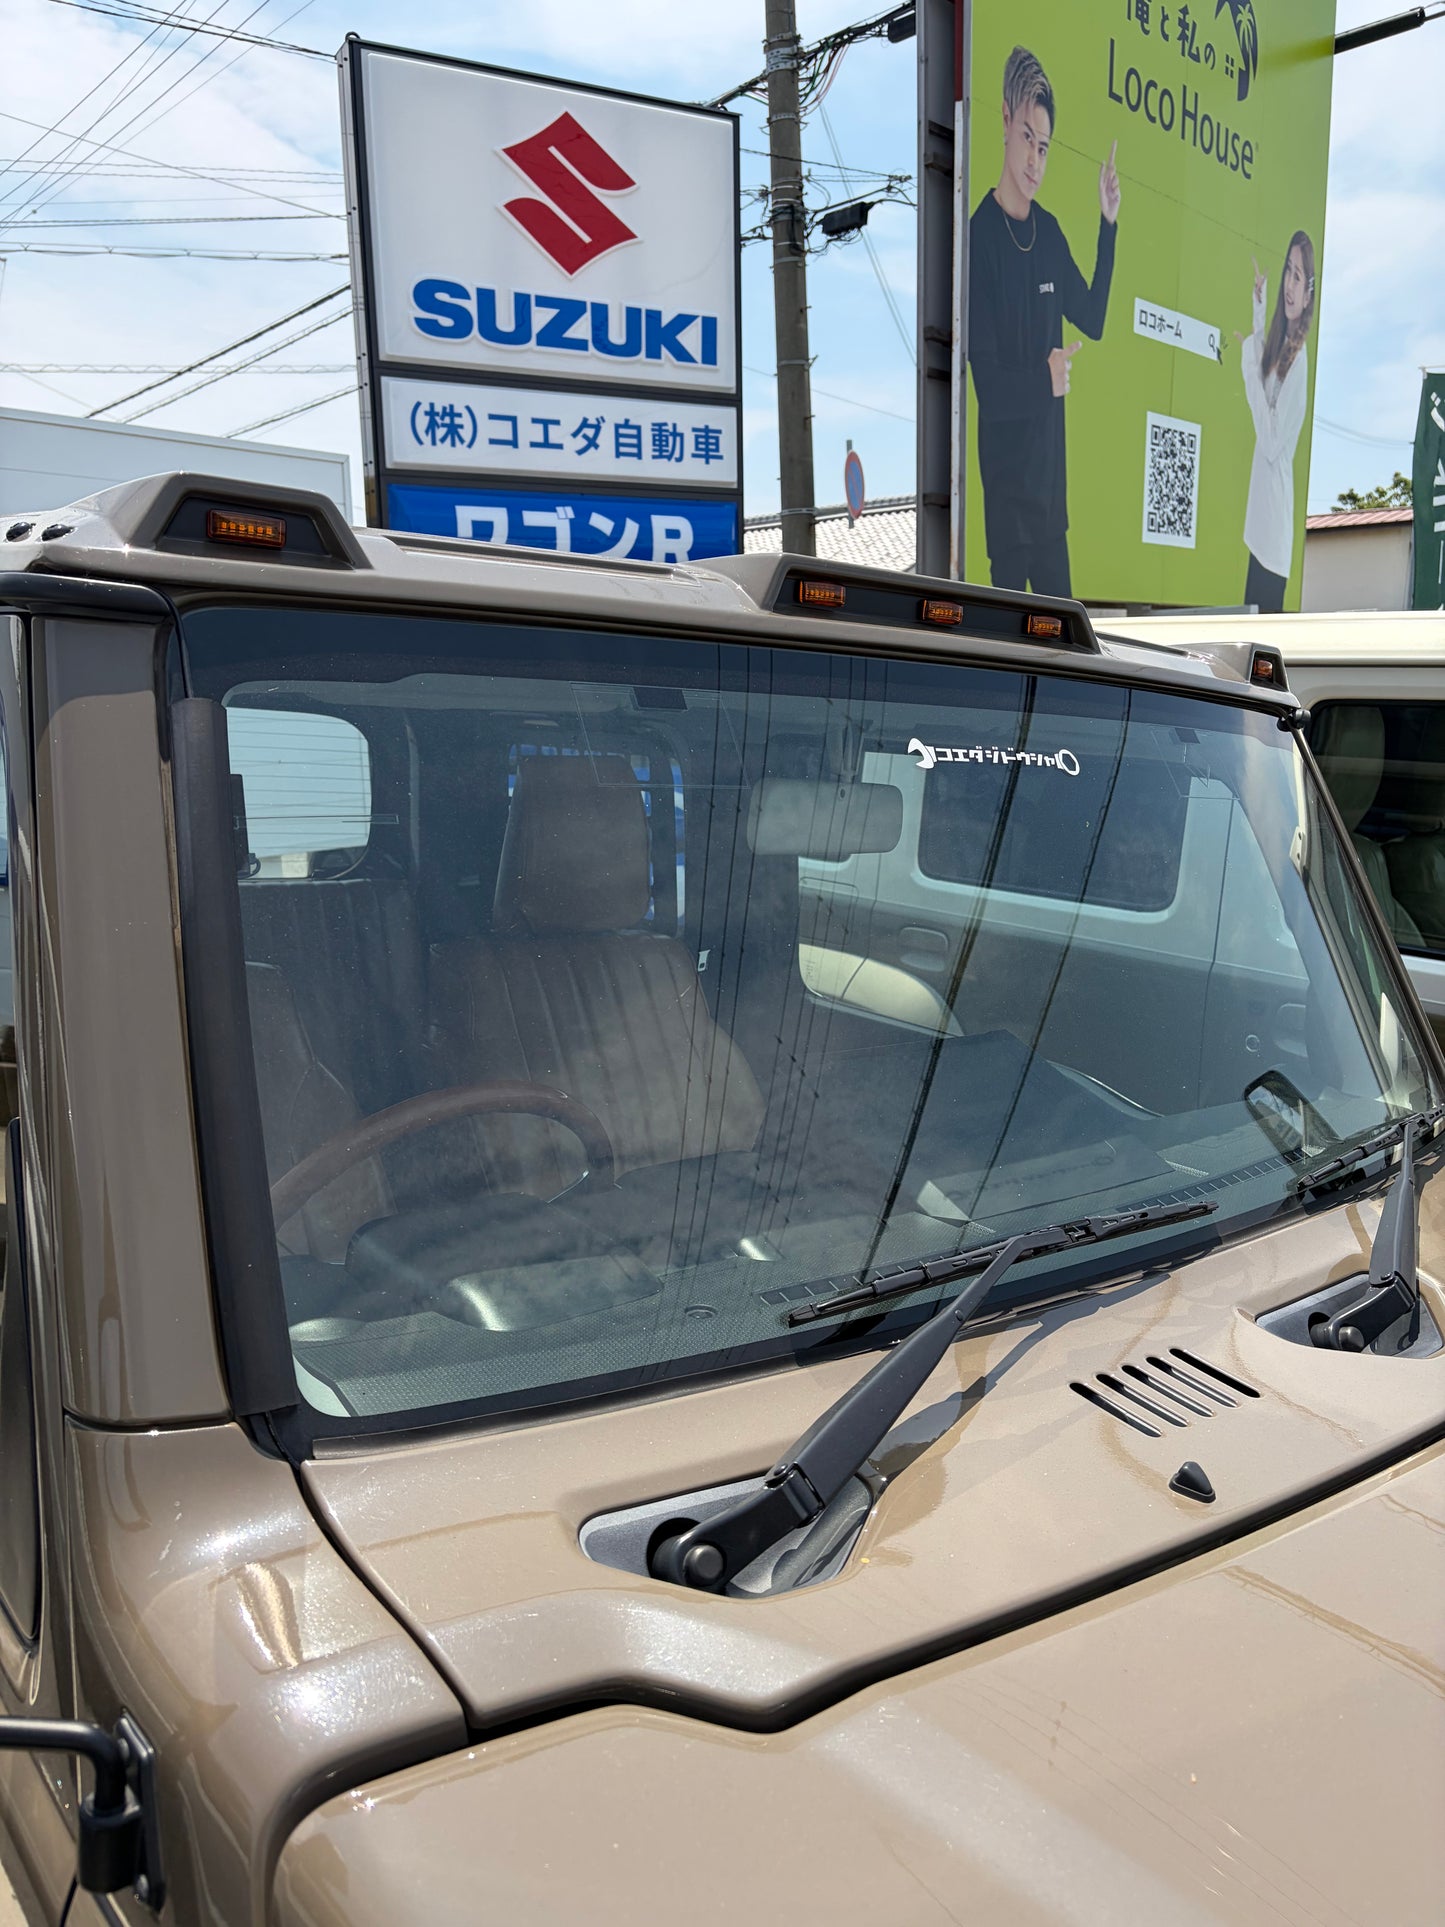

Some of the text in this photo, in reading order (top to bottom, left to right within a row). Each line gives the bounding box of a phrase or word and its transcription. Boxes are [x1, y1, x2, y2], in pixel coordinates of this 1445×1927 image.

[412, 277, 718, 366] SUZUKI
[1138, 309, 1182, 339] ロコホーム
[454, 504, 695, 564] ワゴンR
